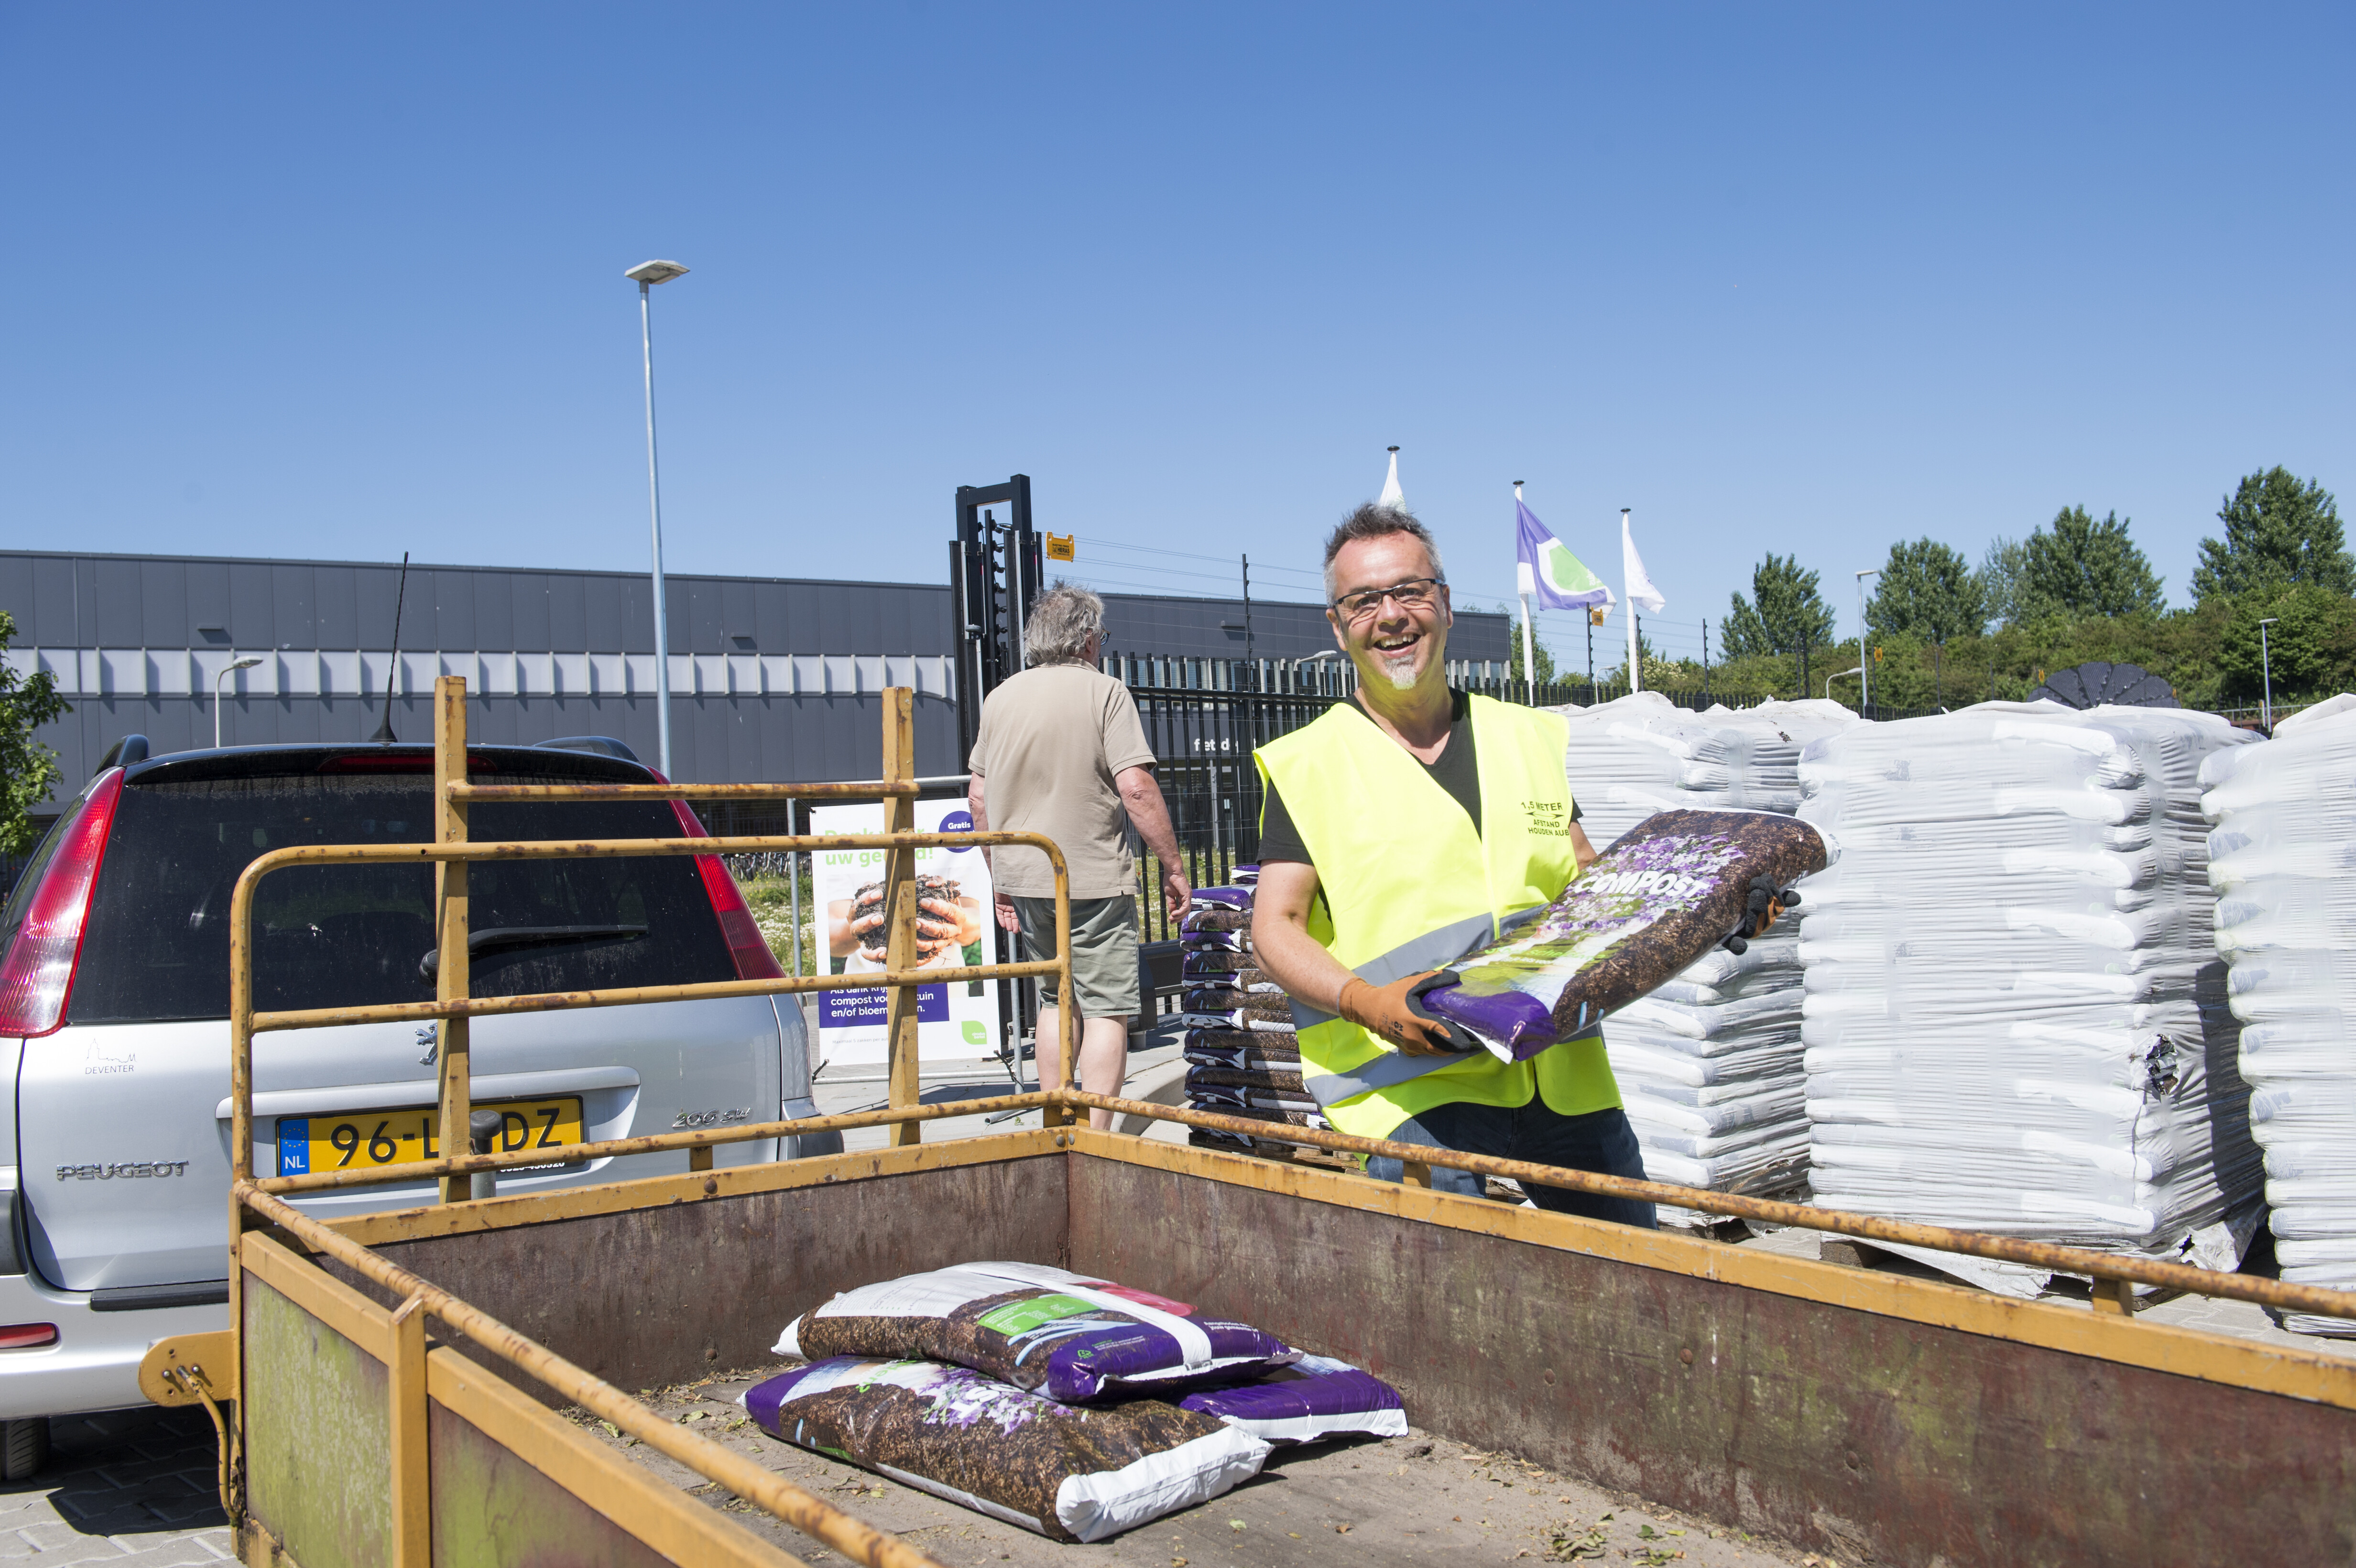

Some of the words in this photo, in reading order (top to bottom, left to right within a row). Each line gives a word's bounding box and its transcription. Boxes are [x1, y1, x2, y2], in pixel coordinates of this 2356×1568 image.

[1521, 801, 1535, 810] 1,5
[1536, 802, 1563, 811] METER
[1534, 819, 1560, 828] AFSTAND
[1528, 828, 1553, 836] HOUDEN
[826, 853, 853, 865] uw
[1574, 870, 1710, 898] COMPOST
[831, 995, 873, 1007] compost
[831, 1007, 857, 1017] en/of
[85, 1065, 134, 1074] DEVENTER
[672, 1109, 718, 1128] 206
[720, 1107, 752, 1123] SW
[330, 1107, 562, 1166] 96-LDZ
[284, 1156, 306, 1169] NL
[56, 1160, 189, 1181] PEUGEOT
